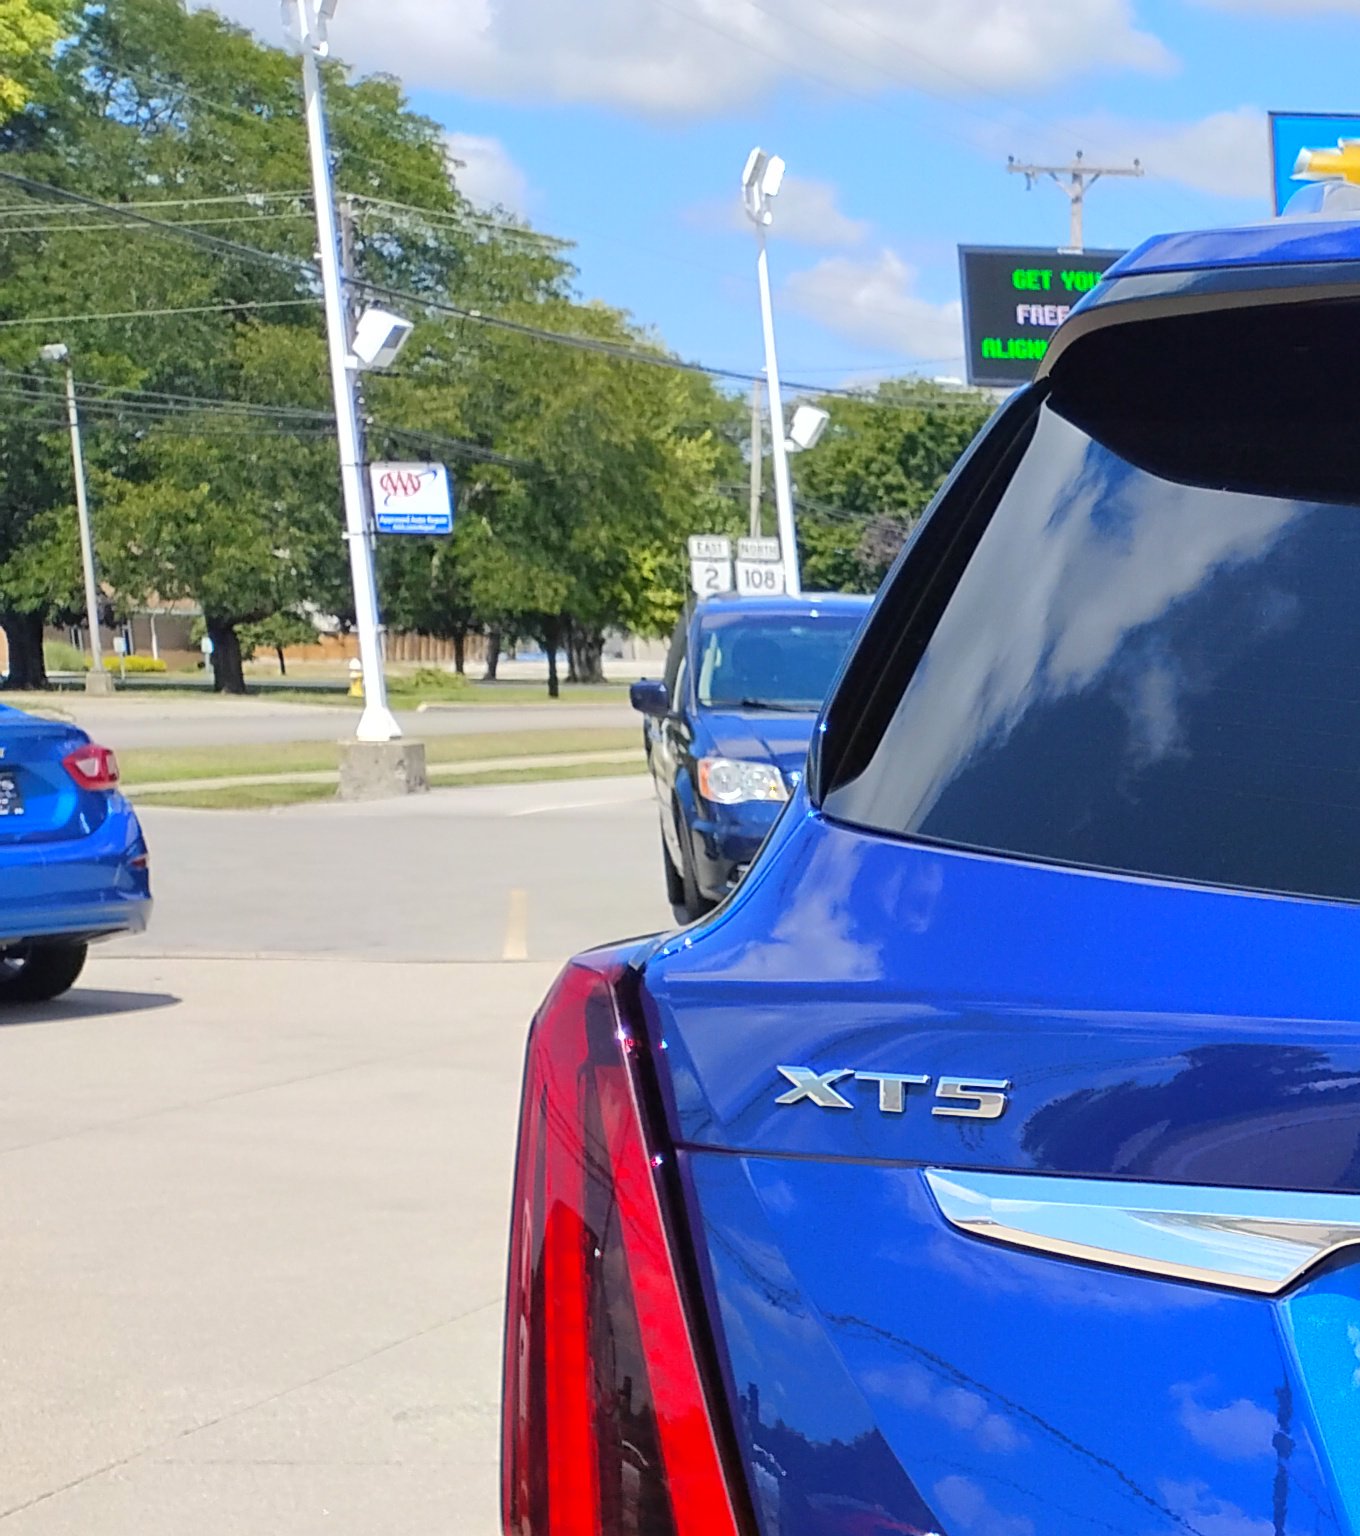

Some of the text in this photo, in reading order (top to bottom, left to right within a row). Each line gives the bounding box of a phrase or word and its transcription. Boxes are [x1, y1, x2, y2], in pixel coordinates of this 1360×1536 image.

[1012, 269, 1052, 290] GET
[1016, 304, 1070, 325] FREE
[696, 542, 722, 554] EAST
[741, 543, 776, 554] NORTH
[705, 568, 720, 590] 2
[744, 569, 776, 590] 108
[774, 1064, 1014, 1119] XT5
